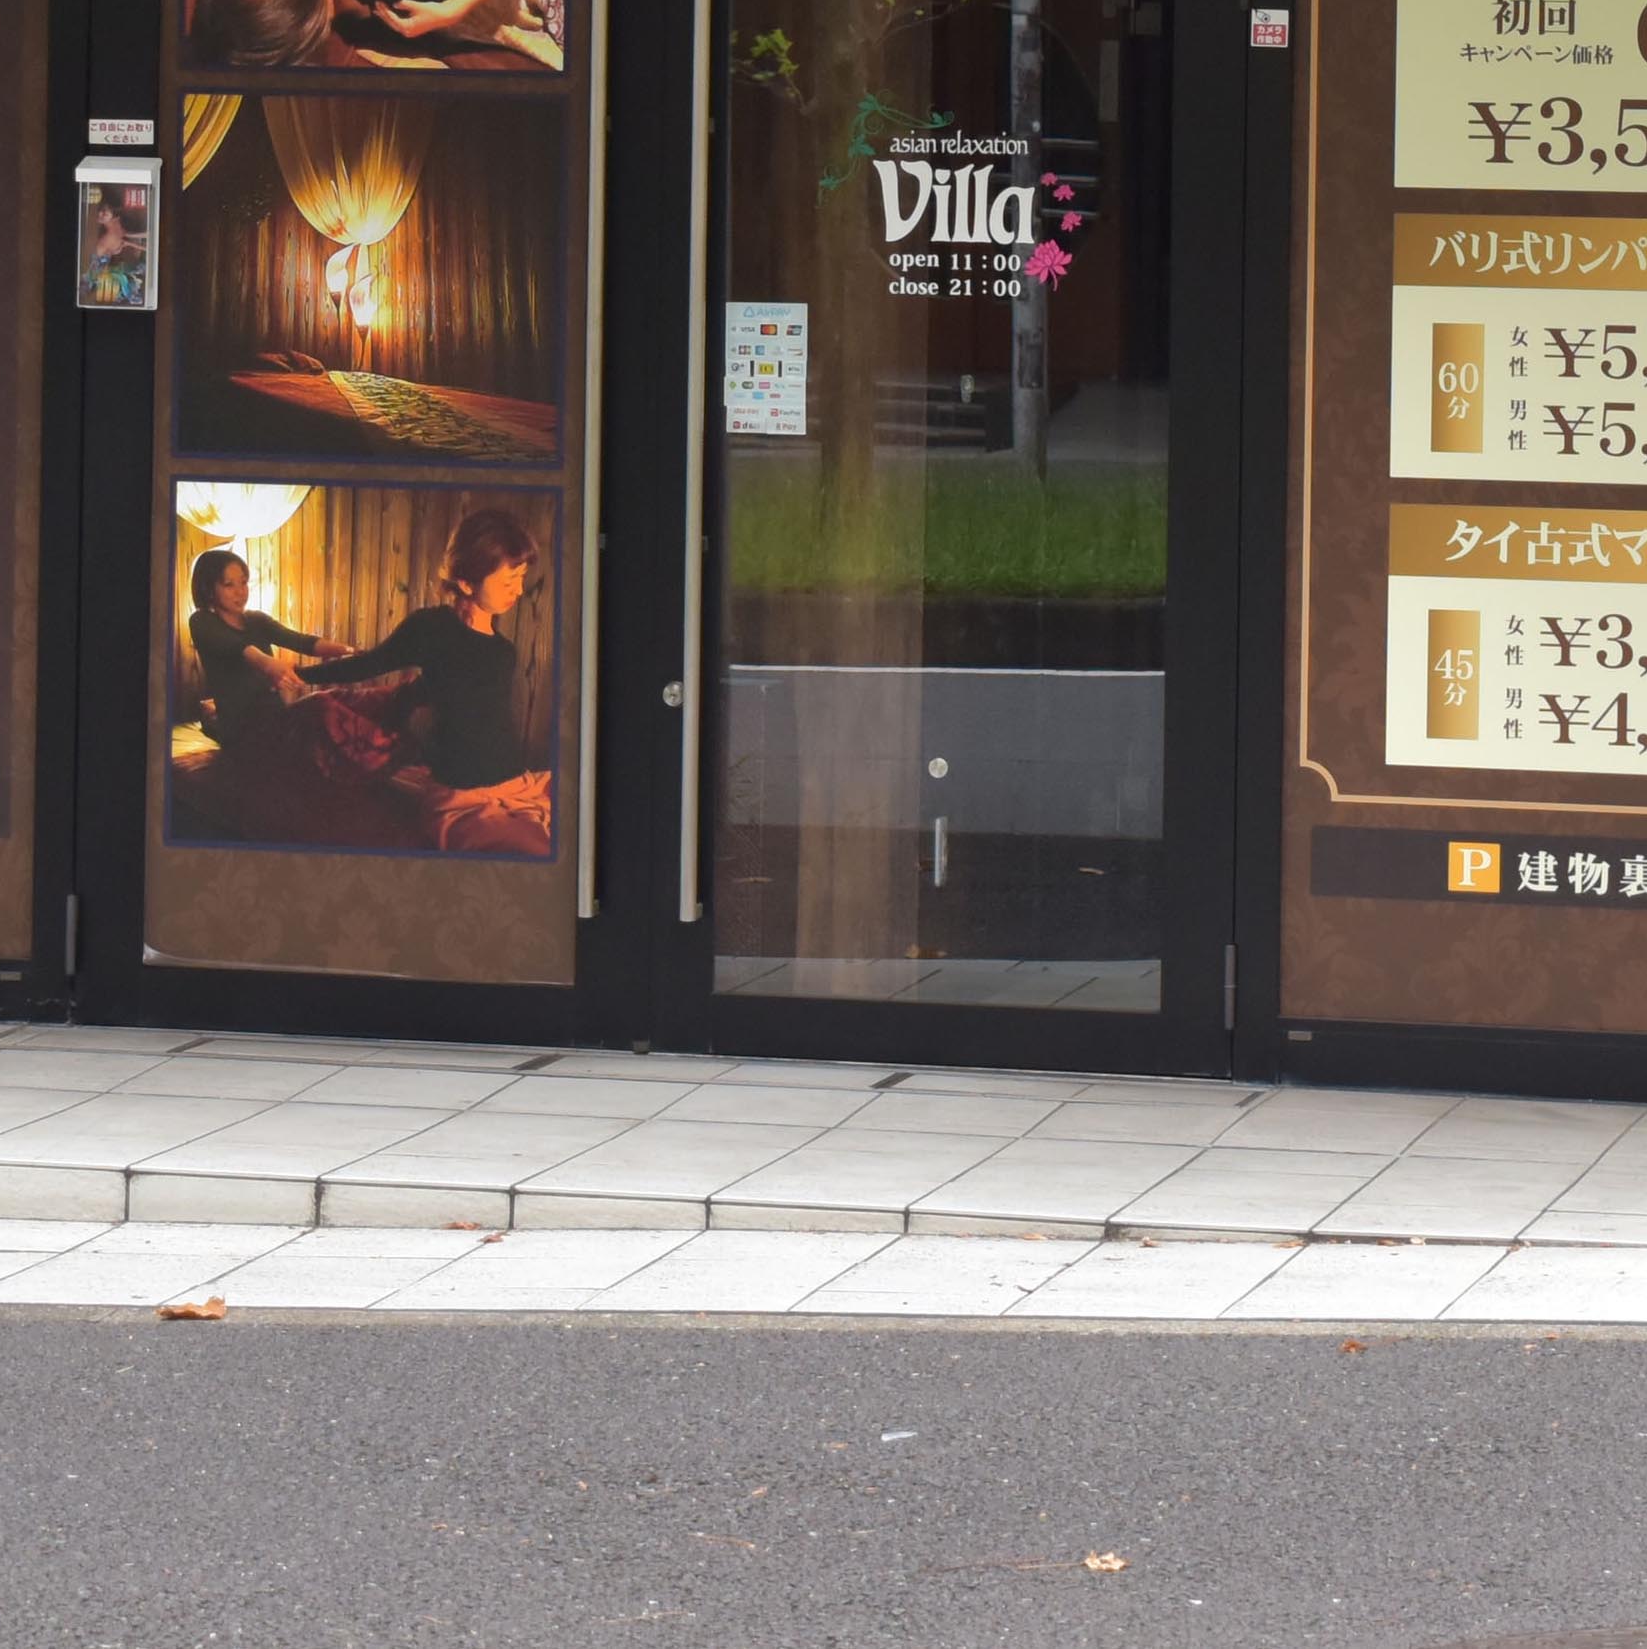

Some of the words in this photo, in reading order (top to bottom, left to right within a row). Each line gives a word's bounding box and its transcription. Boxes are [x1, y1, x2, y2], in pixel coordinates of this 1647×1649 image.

[1257, 26, 1282, 34] カメラ
[1460, 42, 1614, 66] キャンペーン価格
[890, 130, 937, 154] asian
[940, 130, 1028, 155] relaxation
[873, 160, 1035, 244] Villa
[889, 253, 940, 271] open
[889, 277, 939, 295] close
[1509, 326, 1529, 378] 女性
[1438, 362, 1479, 395] 60
[1447, 397, 1471, 420] 分
[1508, 400, 1528, 452] 男性
[1505, 614, 1525, 667] 女性
[1434, 650, 1474, 681] 45
[1443, 683, 1467, 706] 分
[1504, 687, 1524, 740] 男性
[1457, 849, 1492, 886] P
